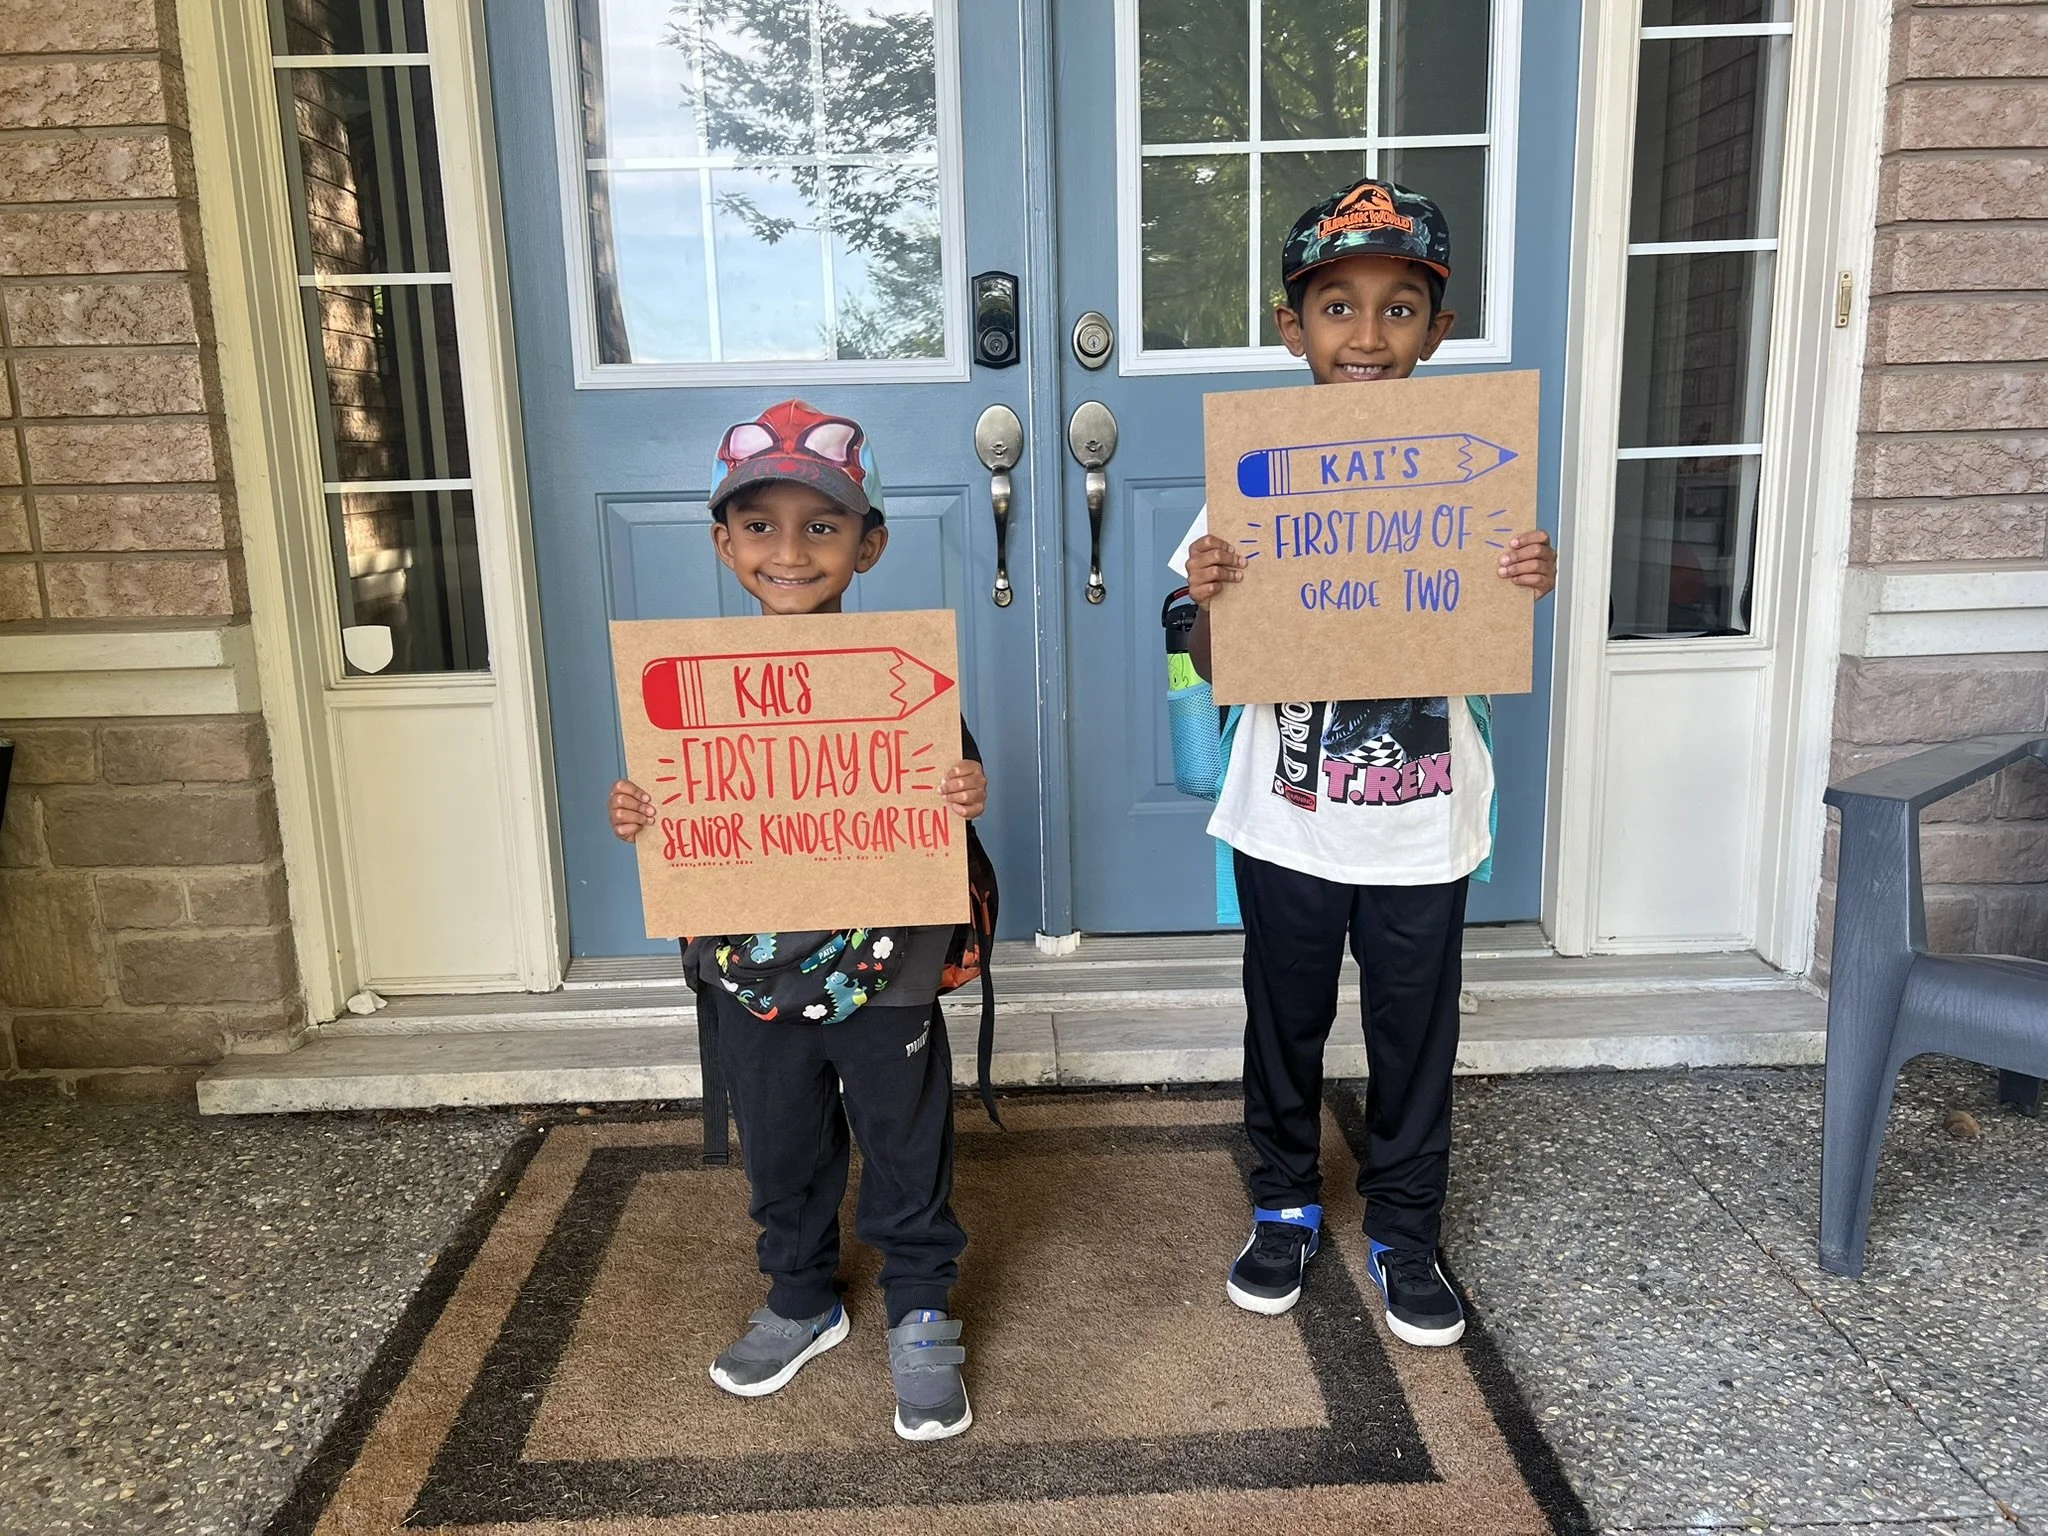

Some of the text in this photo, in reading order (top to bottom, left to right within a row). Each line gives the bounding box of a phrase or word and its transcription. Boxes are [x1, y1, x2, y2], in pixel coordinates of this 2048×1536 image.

[1369, 210, 1409, 228] WORLD
[1321, 446, 1420, 485] KAI'S
[1275, 504, 1473, 559] FIRST DAY OF
[1300, 569, 1461, 612] GRADE TWO
[682, 729, 909, 804] FIRST DAY OF
[1322, 751, 1454, 806] T.REX
